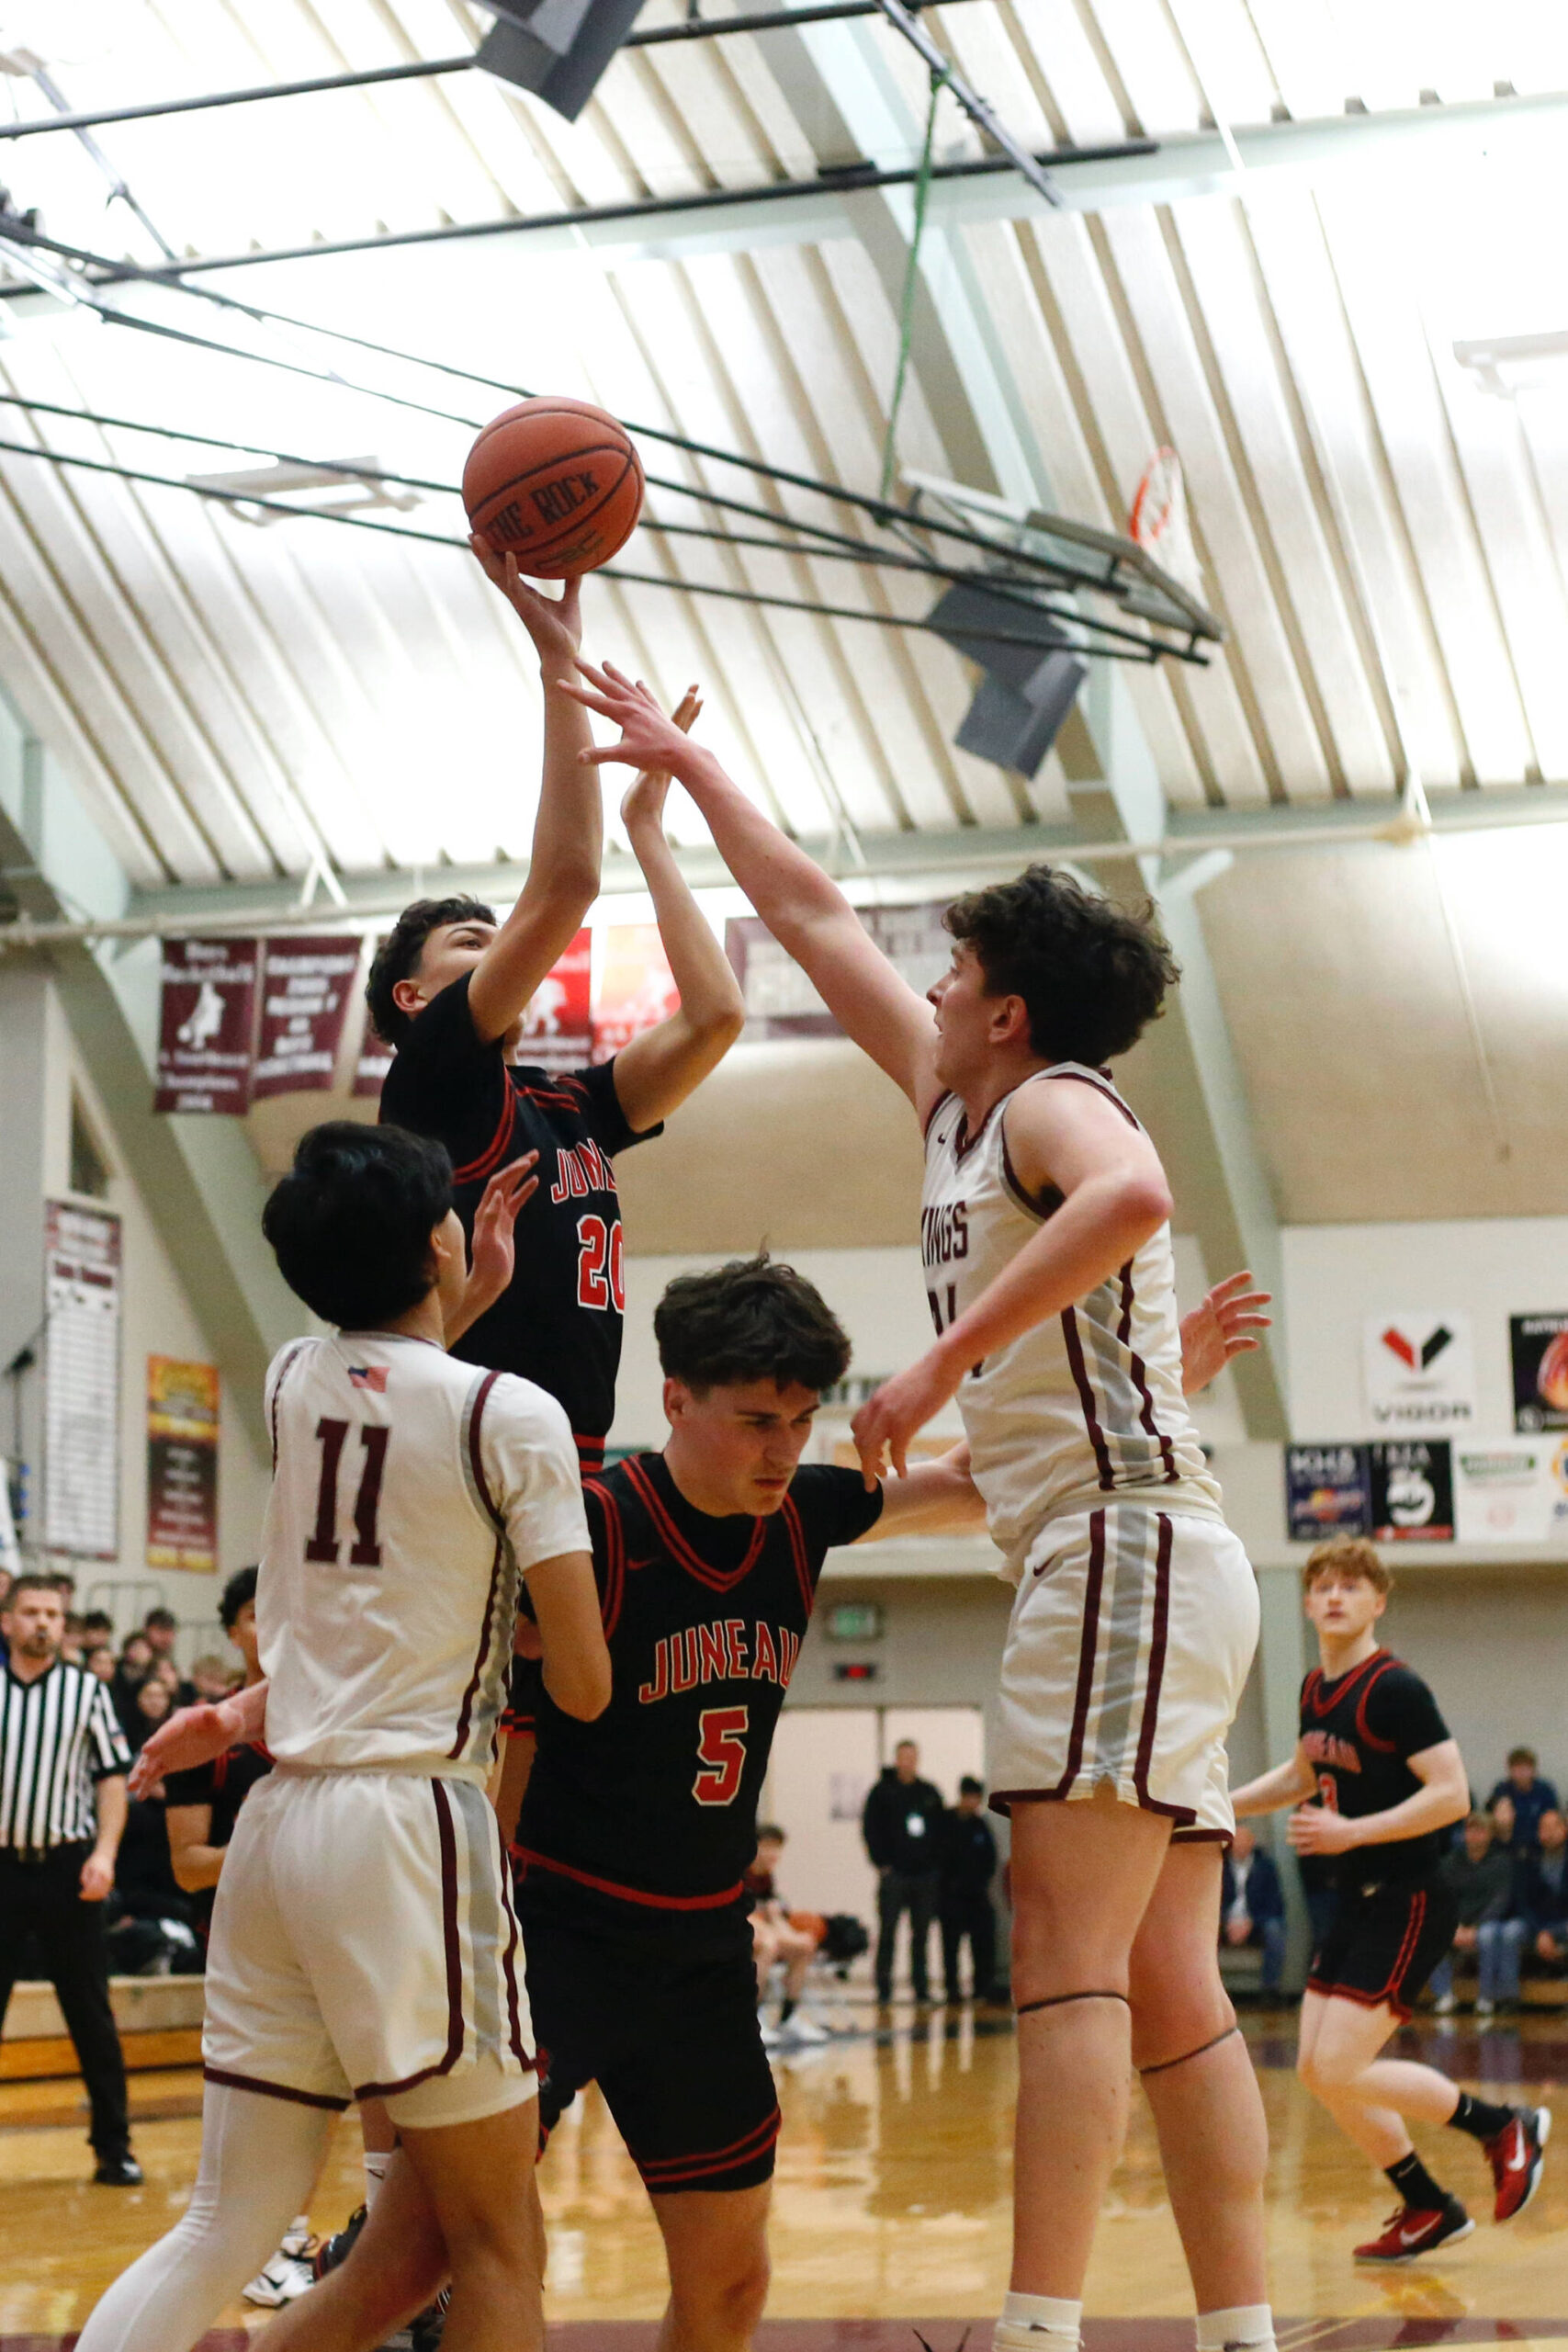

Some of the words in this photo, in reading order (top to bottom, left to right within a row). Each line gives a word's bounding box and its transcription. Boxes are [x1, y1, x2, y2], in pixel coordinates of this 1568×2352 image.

[485, 501, 535, 543] THE
[529, 470, 599, 526] ROCK
[576, 1214, 625, 1315] 20
[1373, 1402, 1472, 1421] VIGOR
[306, 1417, 389, 1566] 11
[638, 1619, 798, 1703] JUNEAU
[692, 1705, 749, 1806] 5
